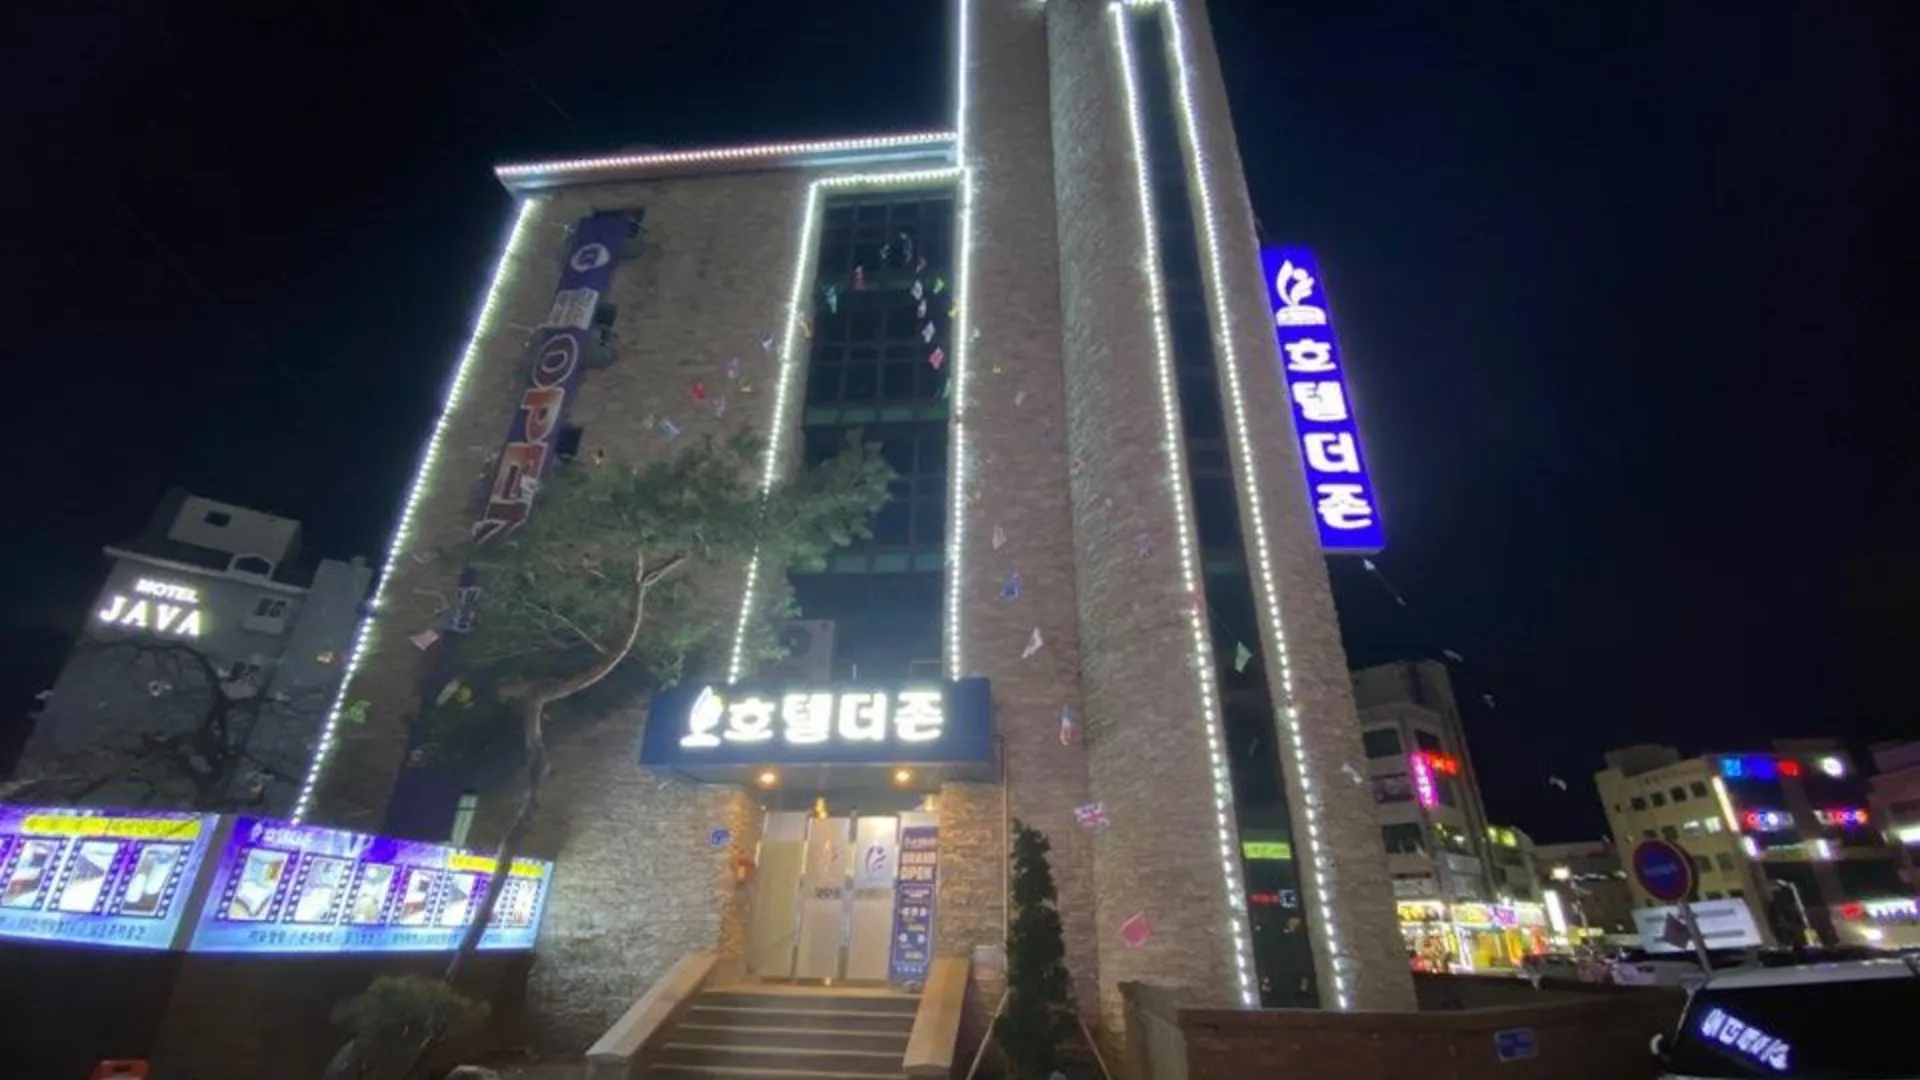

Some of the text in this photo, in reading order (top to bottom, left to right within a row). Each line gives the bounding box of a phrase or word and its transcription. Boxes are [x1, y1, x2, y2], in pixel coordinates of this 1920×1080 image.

[1283, 338, 1373, 530] 호텔더존
[135, 577, 199, 604] MOTEL
[98, 595, 200, 636] JAVA
[723, 691, 944, 744] 호텔더존
